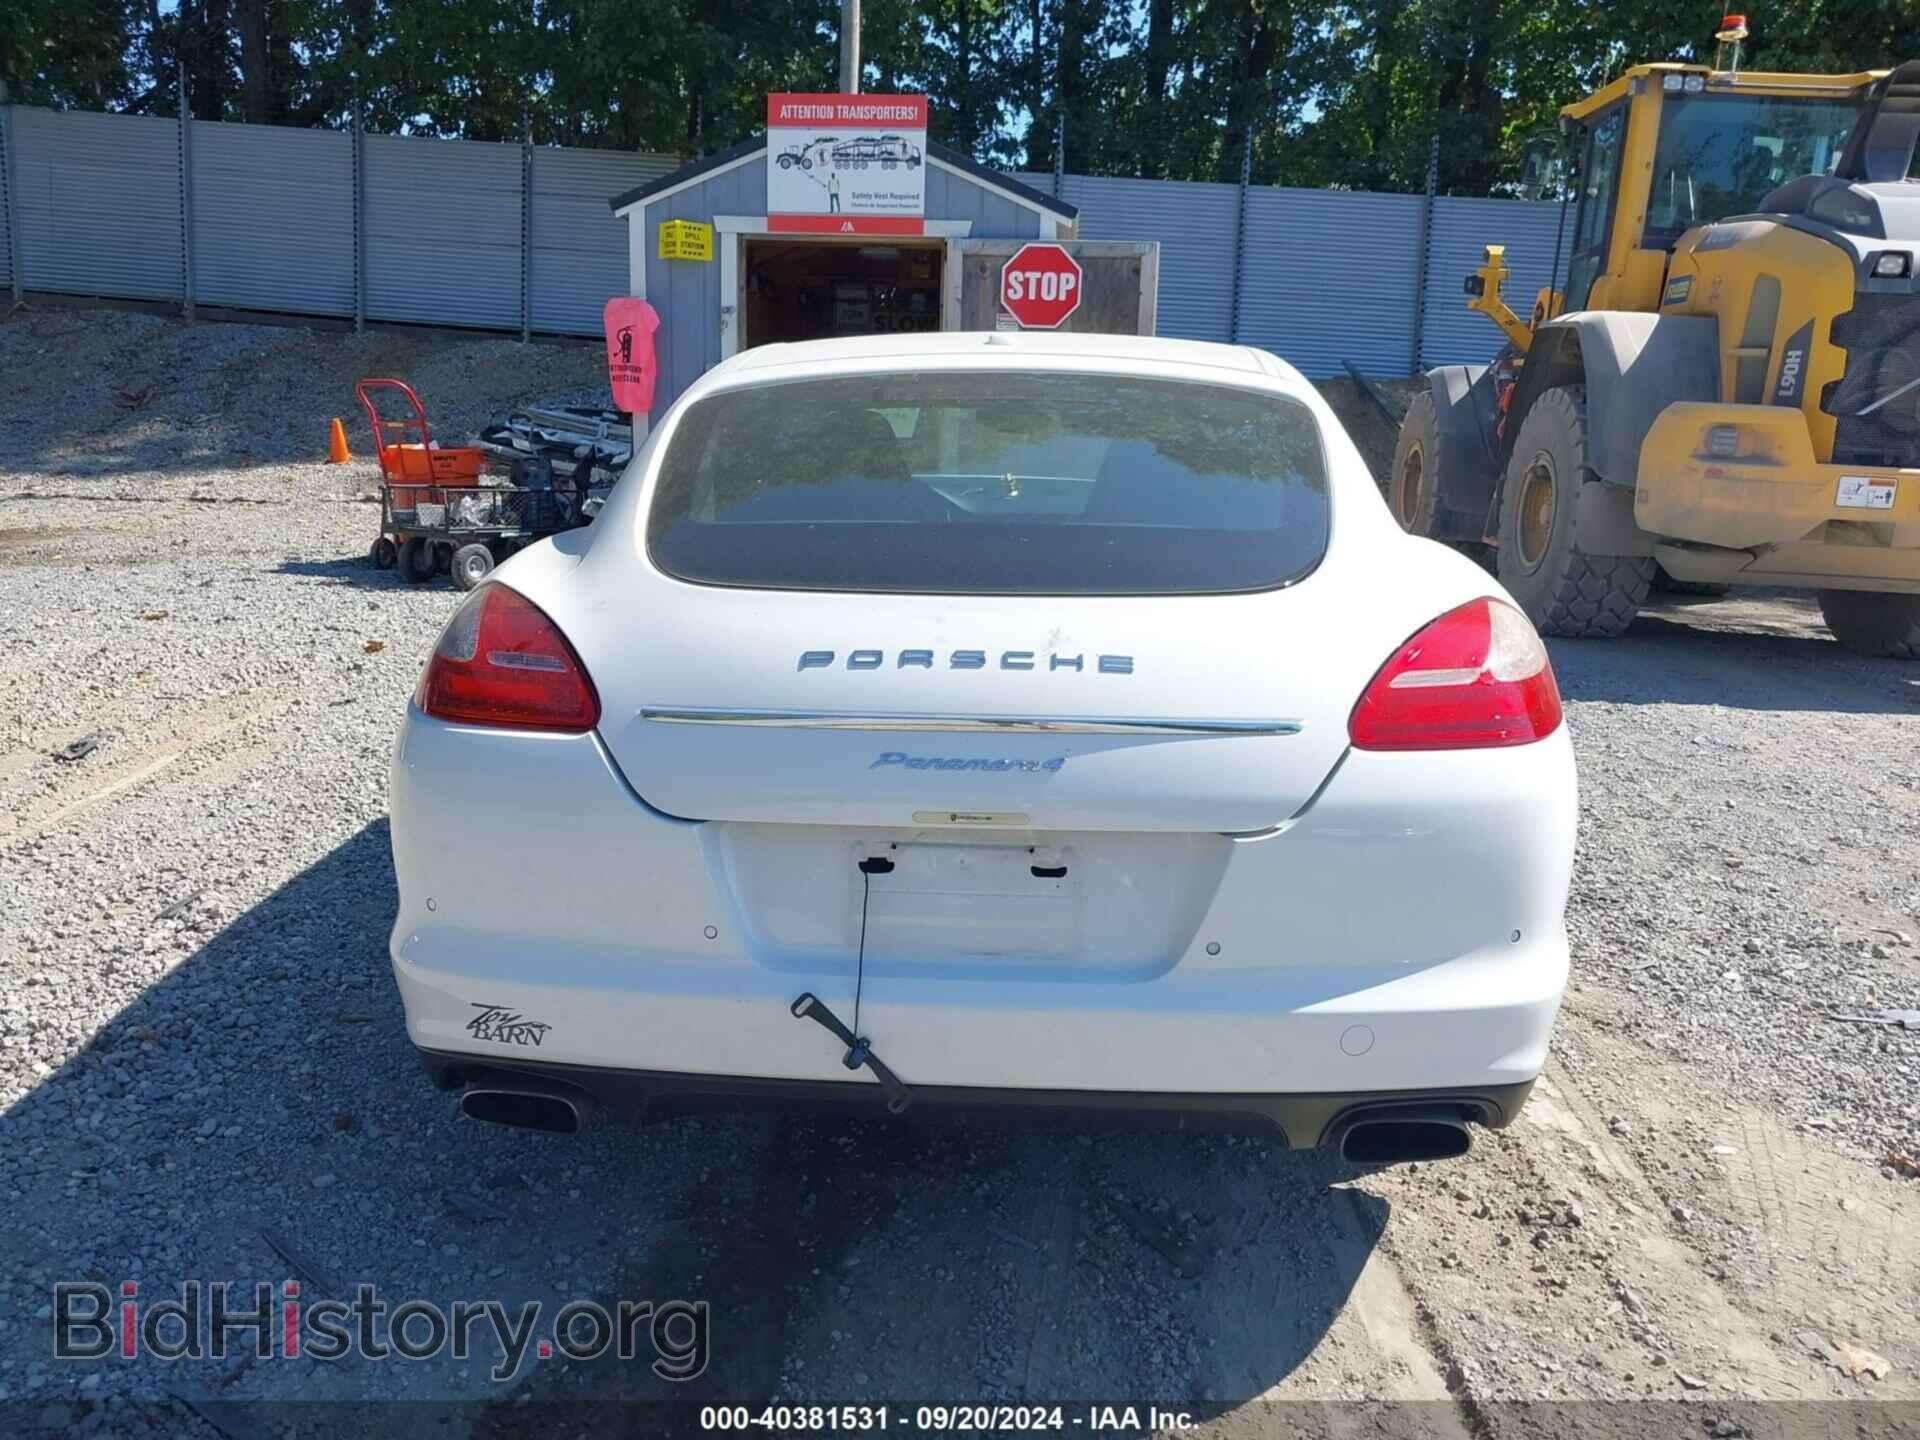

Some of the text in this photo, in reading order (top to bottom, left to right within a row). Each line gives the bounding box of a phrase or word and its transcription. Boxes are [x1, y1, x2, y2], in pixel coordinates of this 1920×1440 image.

[780, 104, 918, 120] ATTENTION TRANSPORTERS!
[1007, 270, 1076, 301] STOP
[1778, 350, 1802, 396] L90H
[797, 649, 1134, 674] PORSCHE
[466, 1002, 540, 1031] Toy
[472, 1022, 547, 1046] BARN
